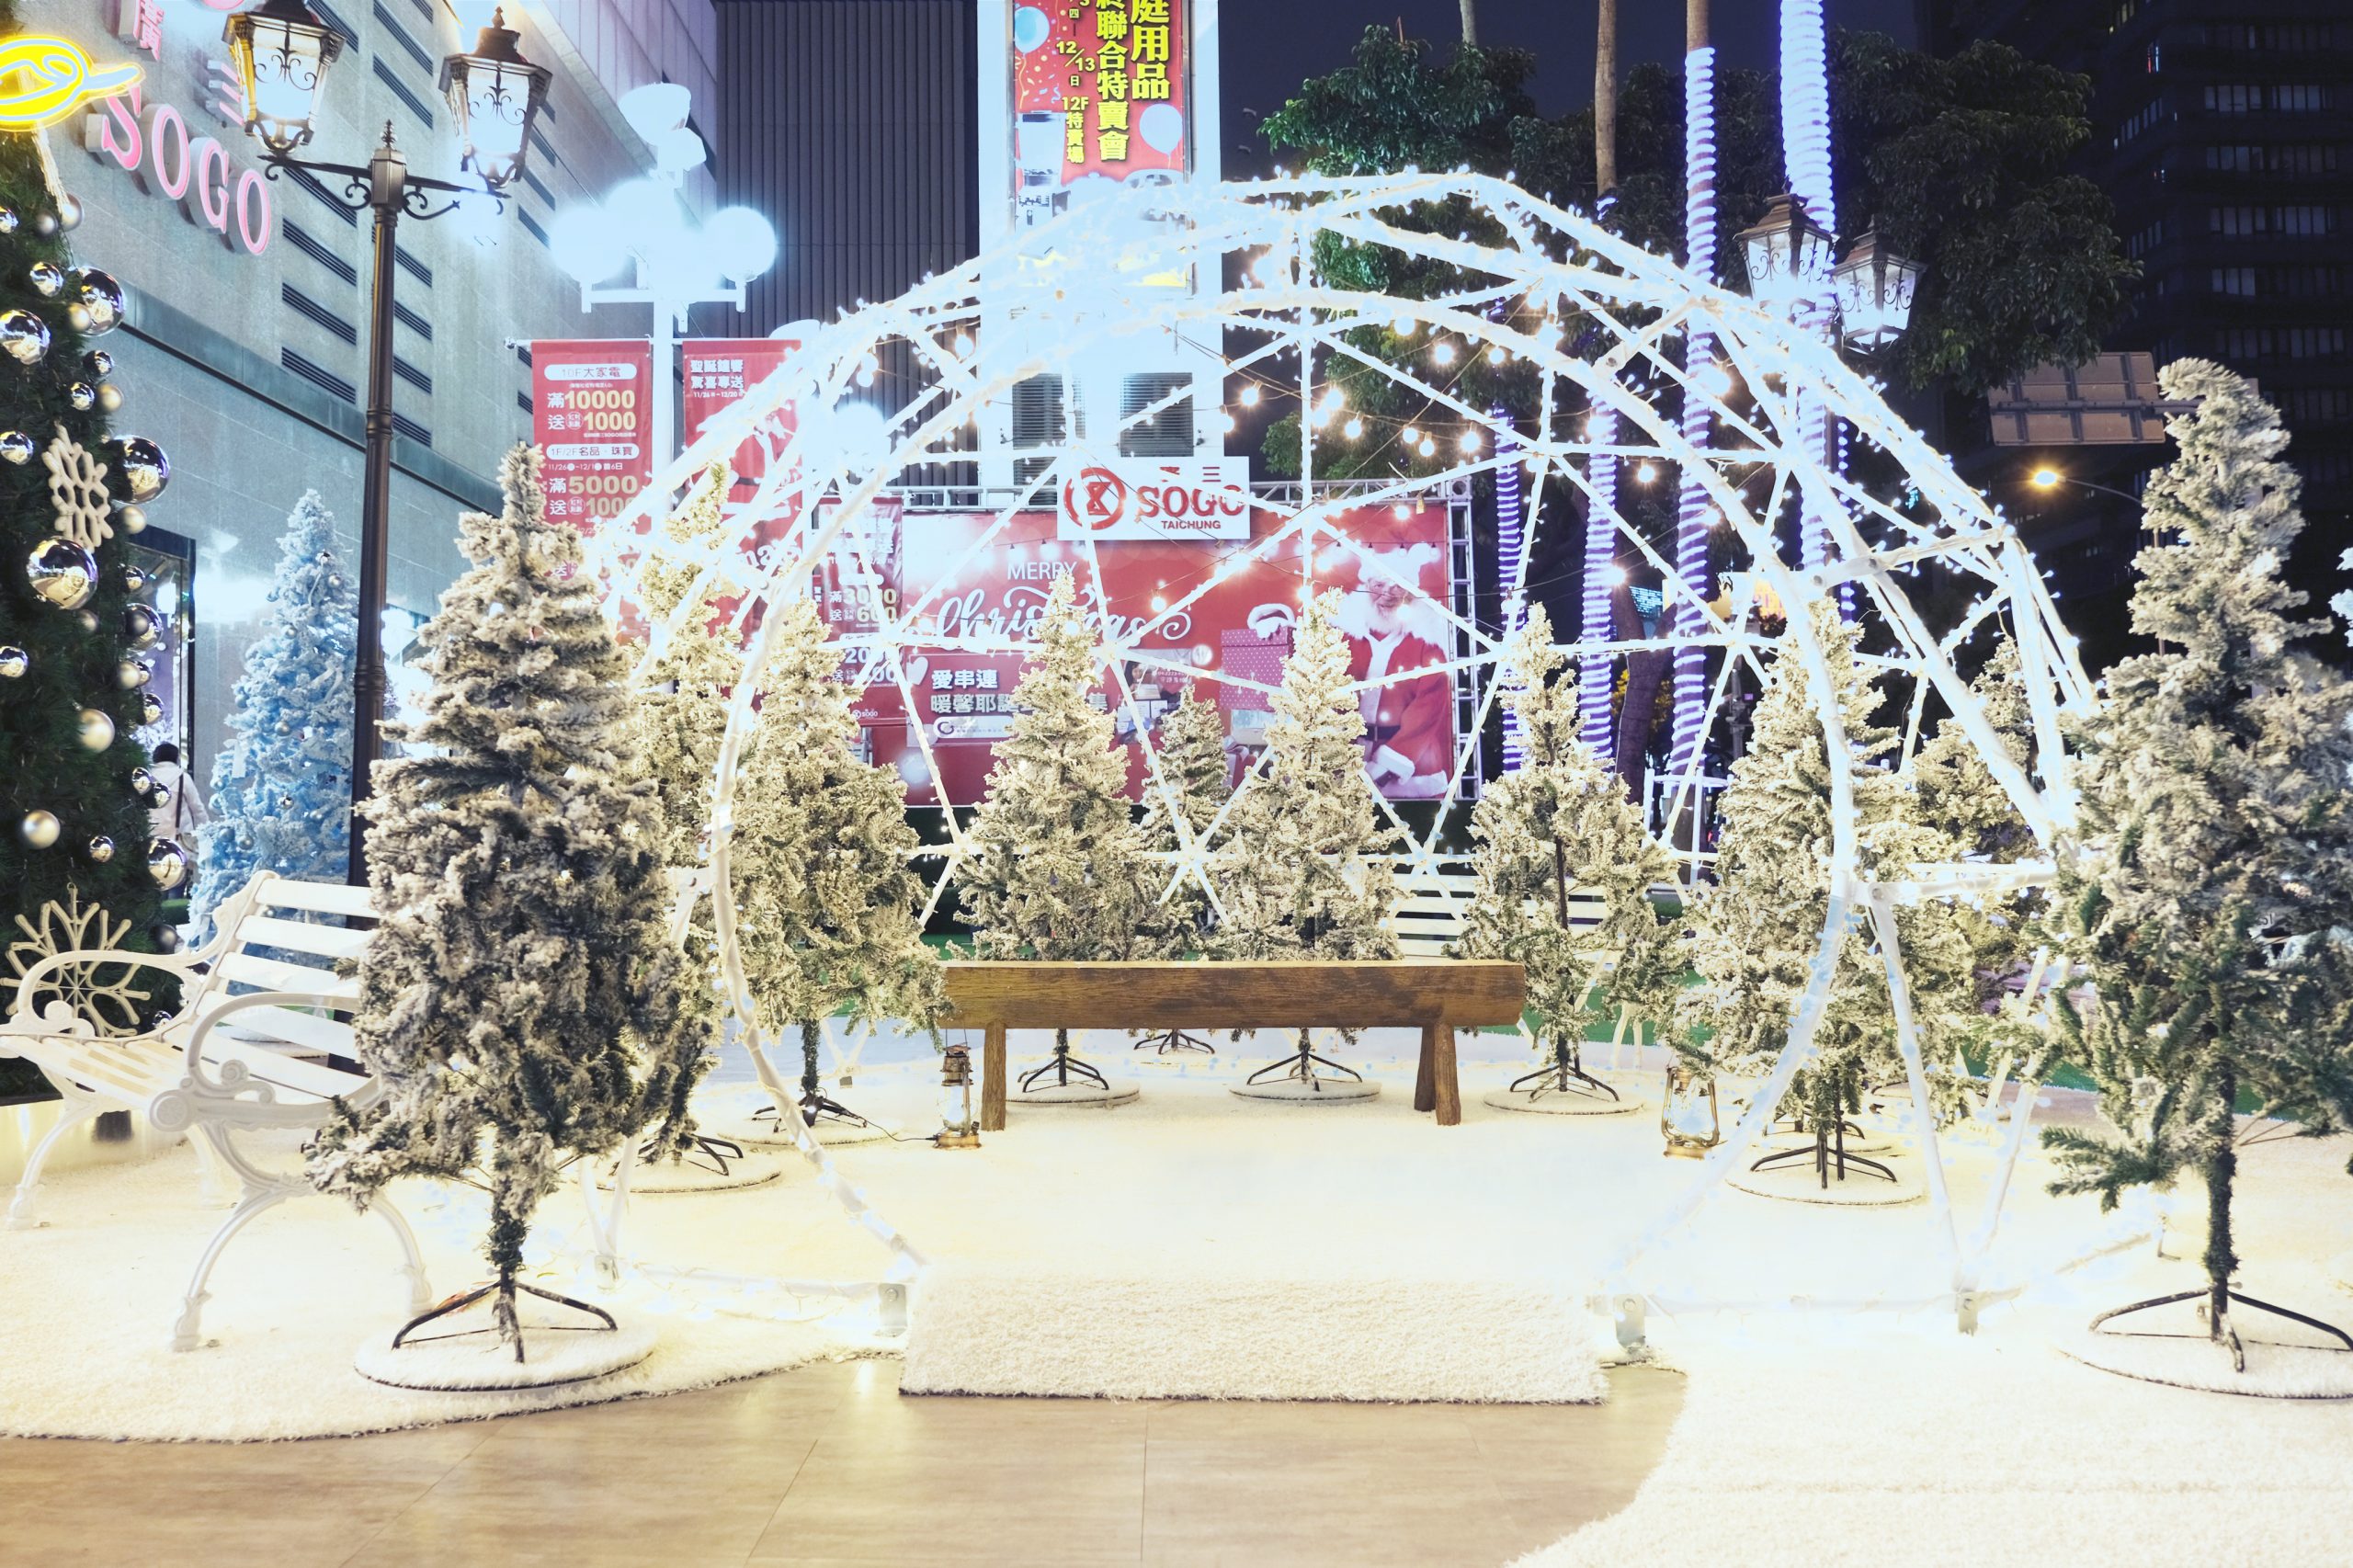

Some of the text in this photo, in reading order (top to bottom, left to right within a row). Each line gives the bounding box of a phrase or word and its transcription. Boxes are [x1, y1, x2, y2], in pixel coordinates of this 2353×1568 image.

[1056, 41, 1096, 72] 12/13
[1063, 97, 1089, 110] 12F
[99, 85, 271, 256] SOGO
[548, 414, 566, 430] 送
[584, 411, 636, 431] 1000
[550, 499, 567, 516] 送
[585, 497, 634, 516] 100
[1136, 485, 1245, 517] SOGO
[1162, 520, 1222, 529] TAICHUNG
[1007, 562, 1077, 580] MERRY
[931, 669, 998, 689] 愛串連
